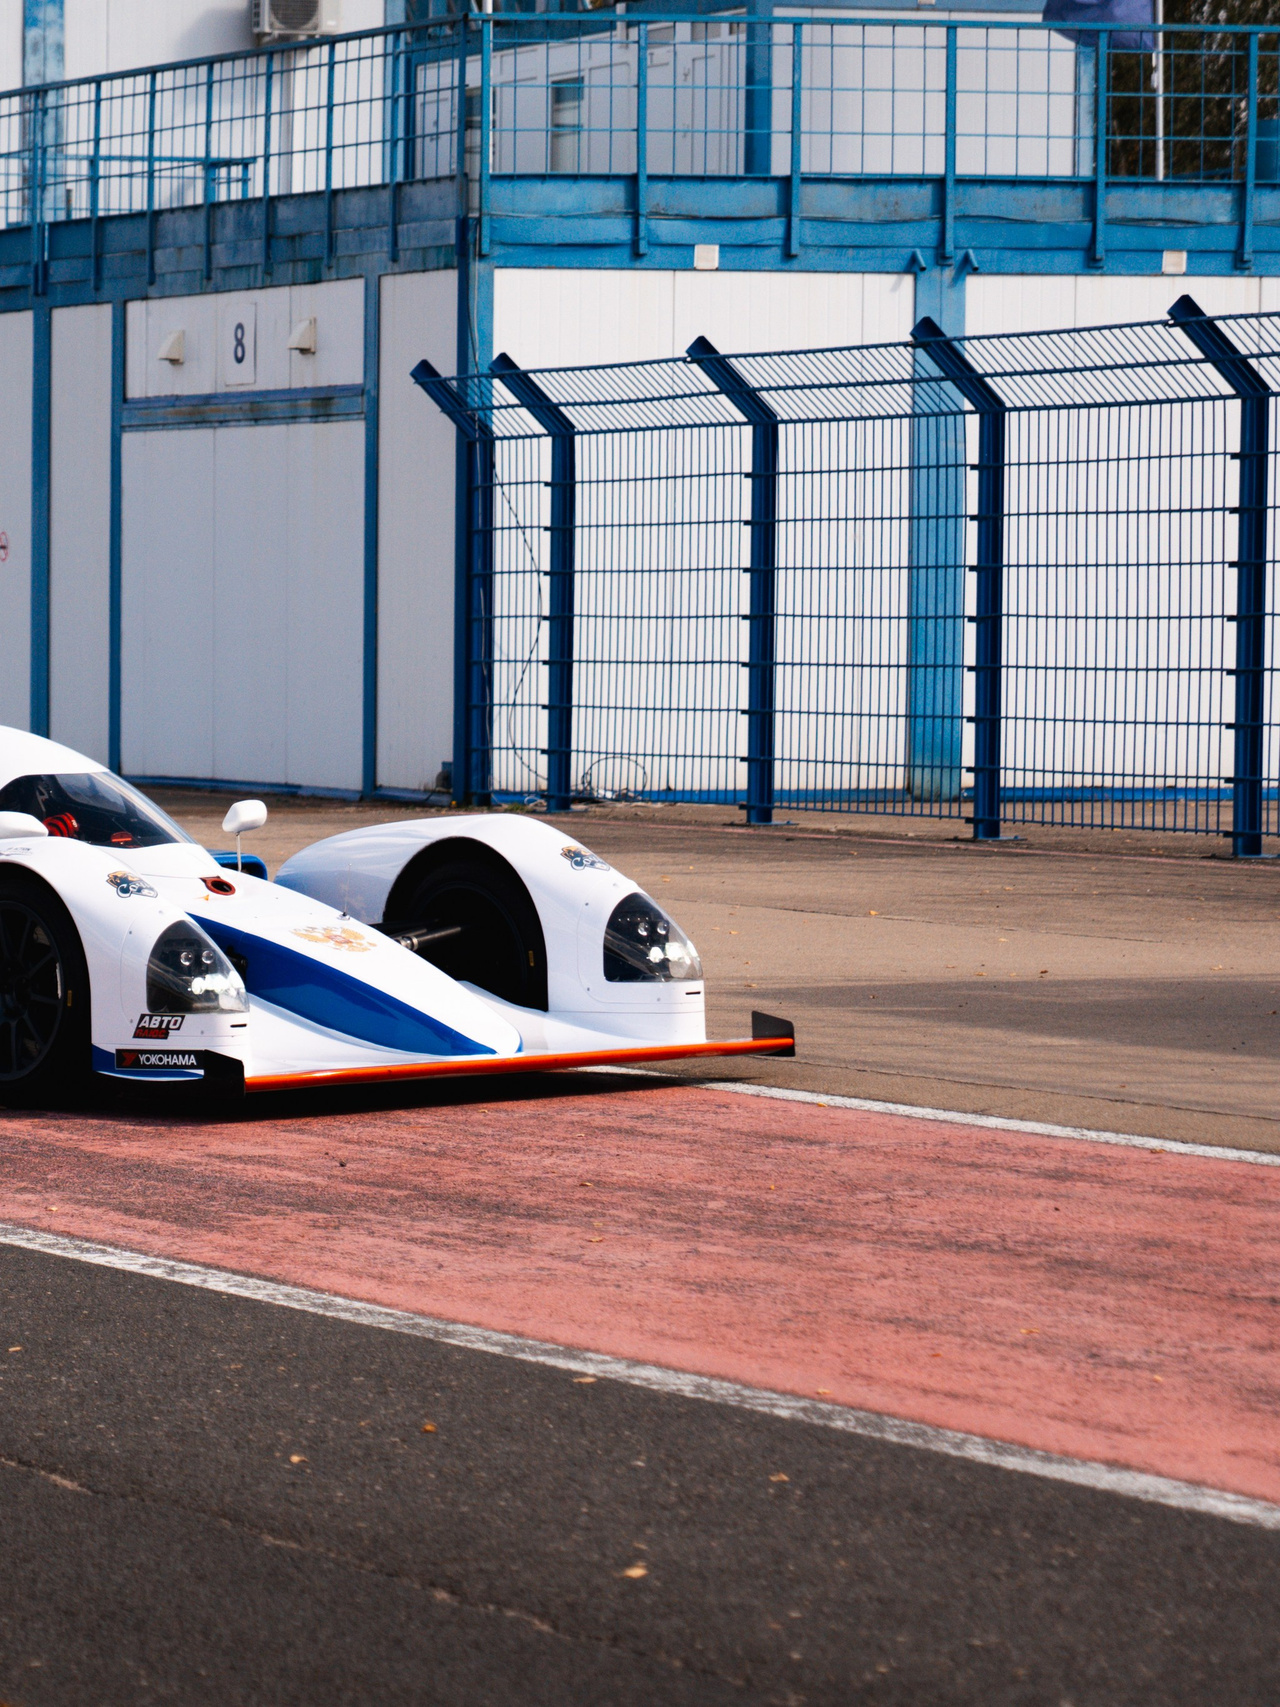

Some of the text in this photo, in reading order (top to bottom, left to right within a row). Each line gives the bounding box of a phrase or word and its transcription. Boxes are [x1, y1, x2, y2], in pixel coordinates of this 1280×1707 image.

[233, 322, 246, 365] 8
[138, 1016, 182, 1029] АВТО
[138, 1054, 197, 1066] YOKOHAMA
